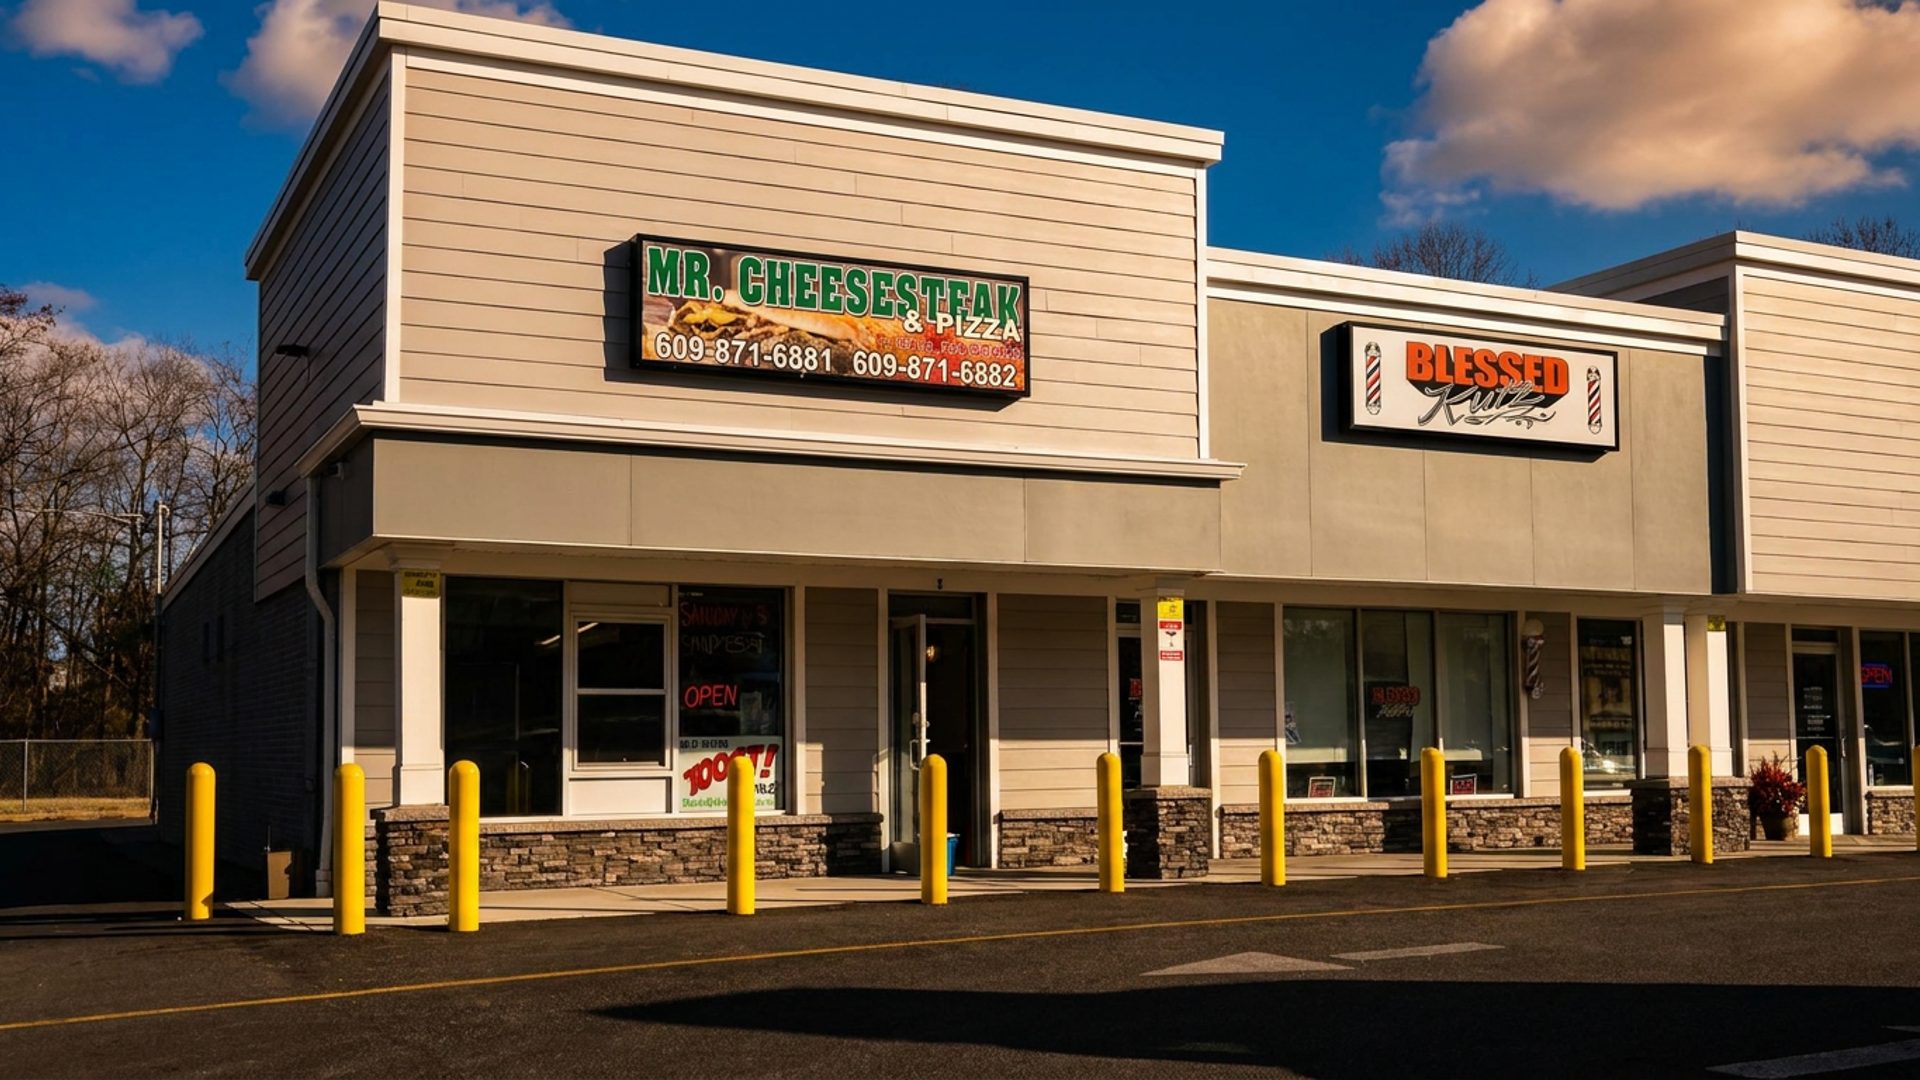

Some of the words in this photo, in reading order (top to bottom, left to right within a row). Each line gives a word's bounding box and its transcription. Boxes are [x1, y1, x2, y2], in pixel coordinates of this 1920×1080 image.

[646, 245, 724, 302] MR.
[738, 254, 1022, 330] CHEESESTEAK
[903, 309, 924, 334] &
[936, 312, 1021, 342] PIZZA
[654, 331, 833, 373] 609-871-6881
[852, 350, 1017, 389] 609-871-6882
[1406, 340, 1569, 396] BLESSED
[683, 684, 738, 708] OPEN
